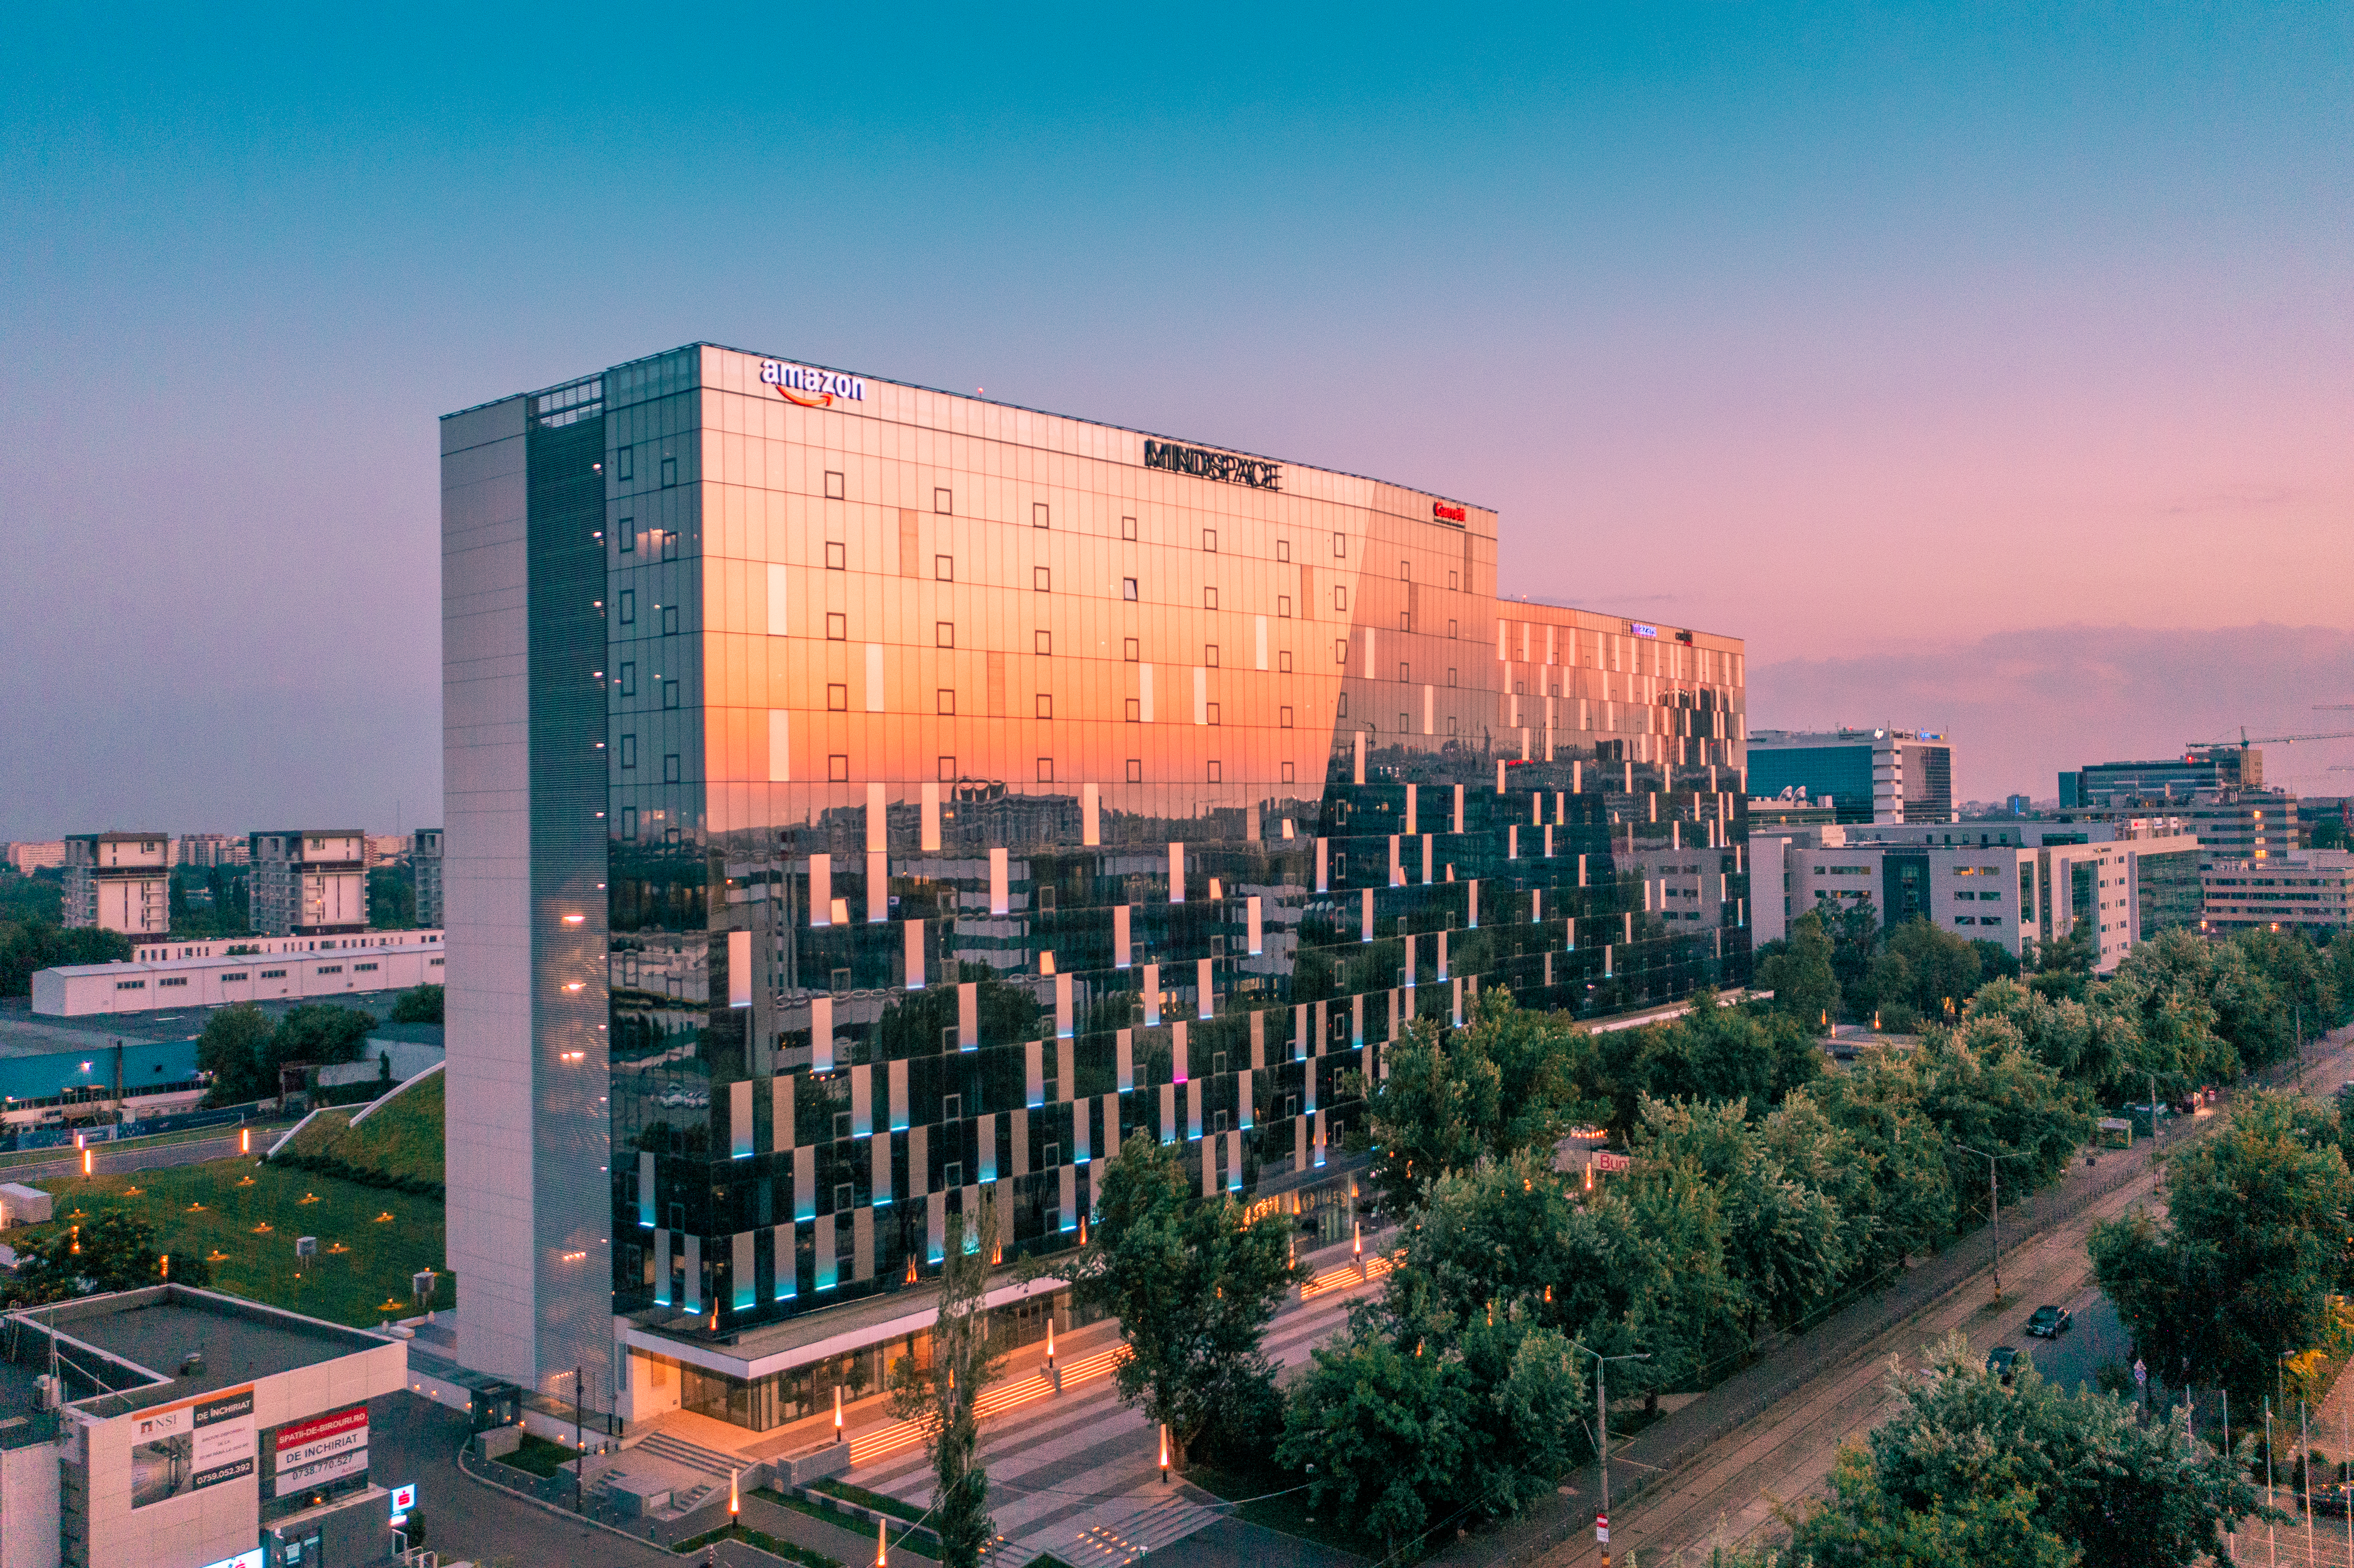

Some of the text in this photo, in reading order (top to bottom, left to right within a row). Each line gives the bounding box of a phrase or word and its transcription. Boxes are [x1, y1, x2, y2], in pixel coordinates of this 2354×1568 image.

[761, 359, 866, 401] amazon
[1144, 439, 1283, 491] MINDSPACE
[197, 1411, 209, 1421] DE
[279, 1413, 366, 1444] SPATII-DE-BIROURI.RO
[286, 1433, 359, 1463] DE INCHIRIAT
[197, 1462, 251, 1484] 0759.052.392
[292, 1453, 353, 1480] 0738.770.527
